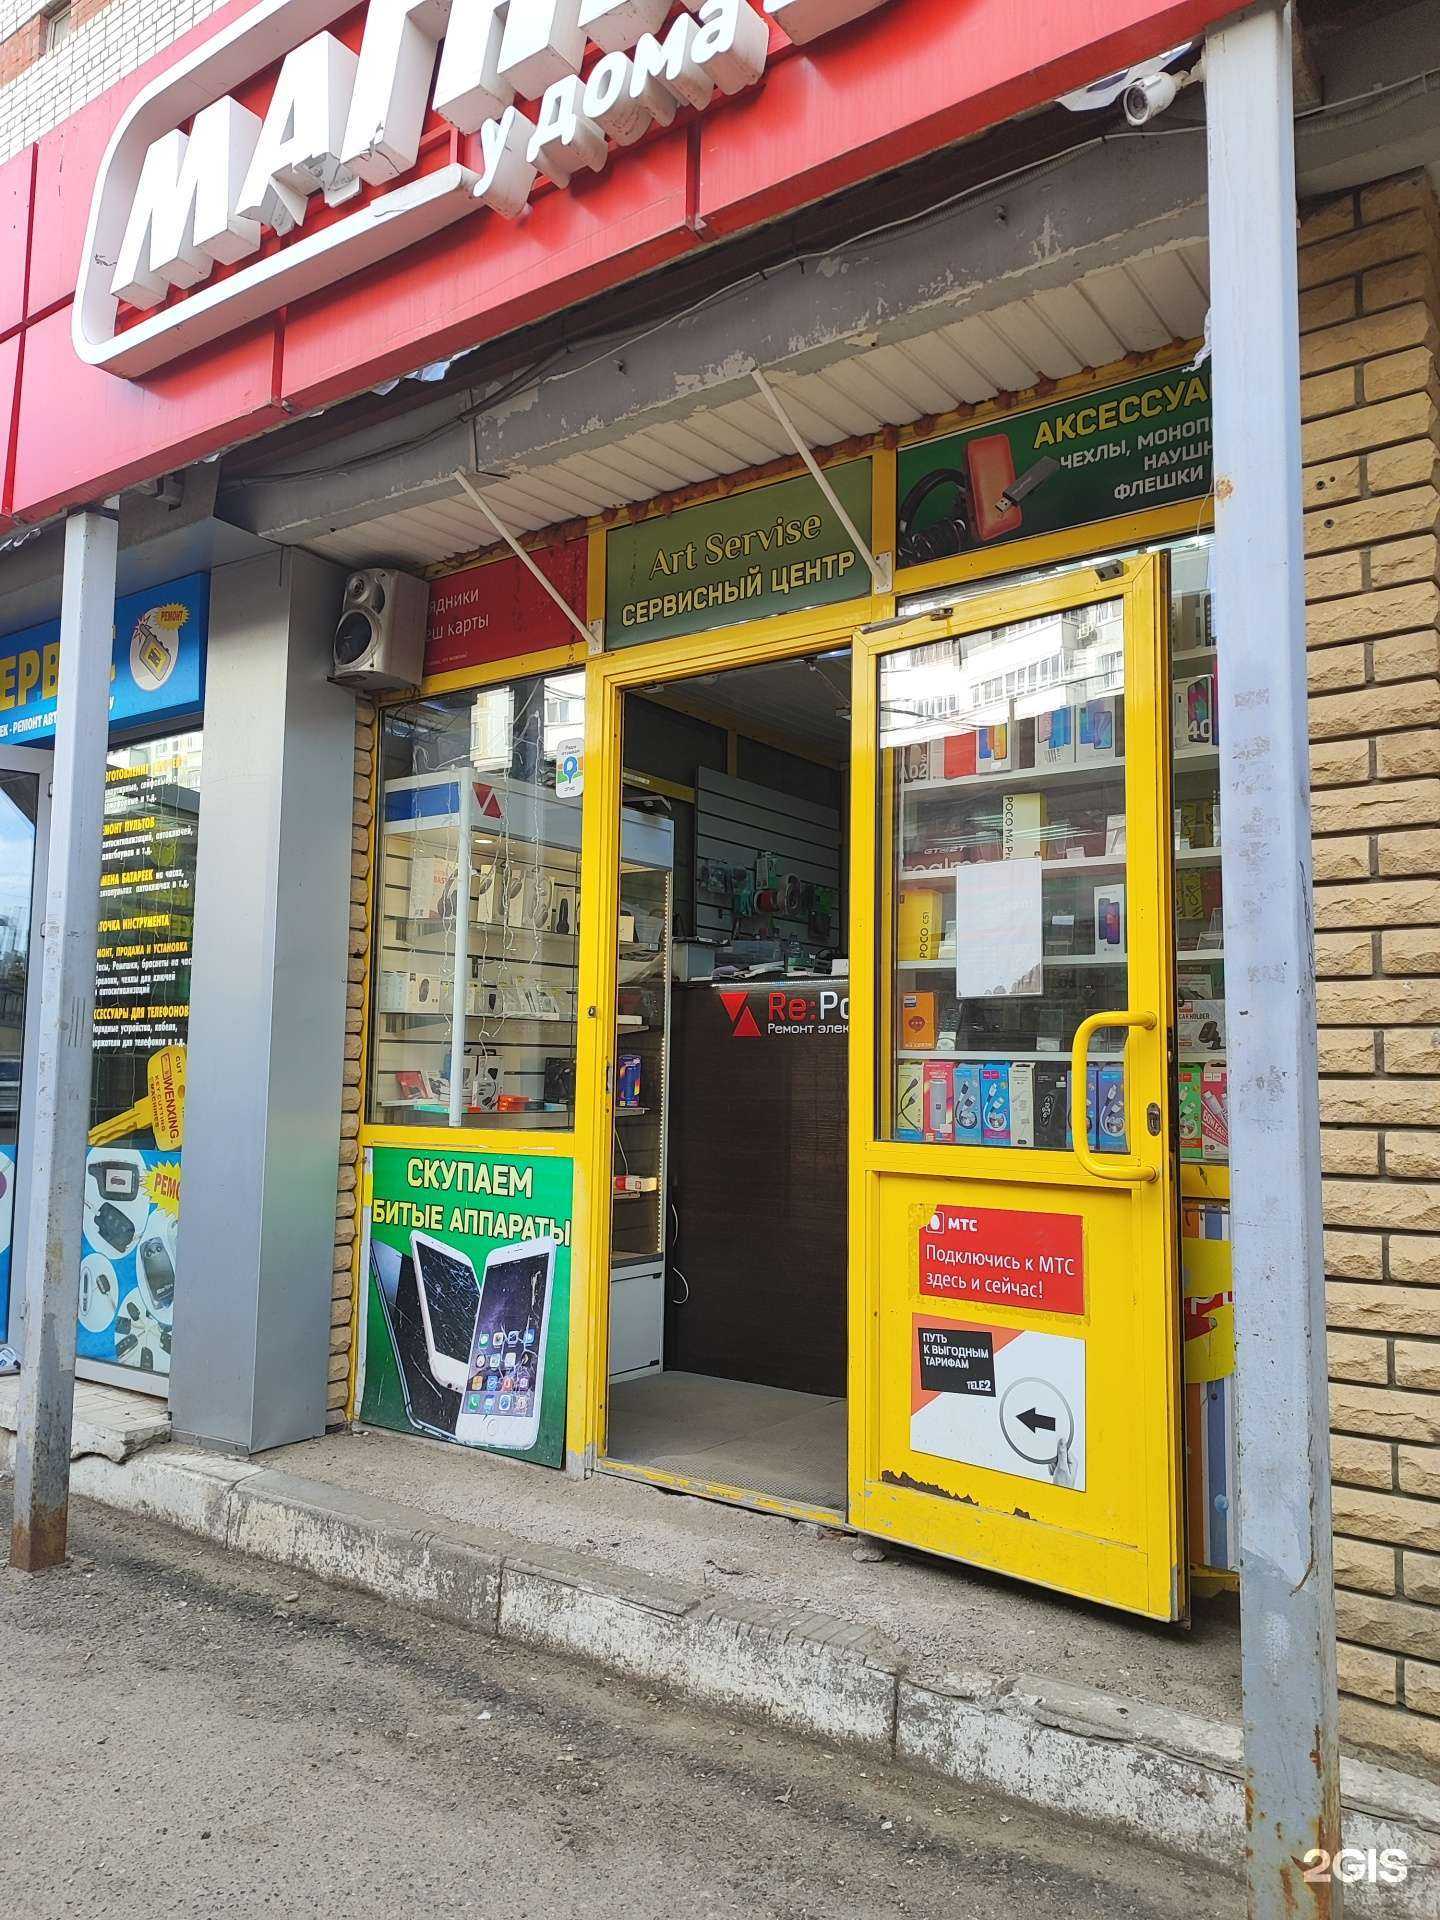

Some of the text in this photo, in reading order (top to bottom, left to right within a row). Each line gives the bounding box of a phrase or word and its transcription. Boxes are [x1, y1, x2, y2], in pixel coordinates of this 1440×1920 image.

[473, 0, 742, 197] у дома
[1060, 417, 1213, 470] ЧЕХЛЫ, МОНОП
[1114, 465, 1203, 500] ФЛЕШКИ
[649, 512, 822, 580] Art Servise
[621, 549, 855, 628] СЕРВИСНЫЙ ЦЕНТР
[448, 614, 489, 637] карты
[13, 715, 42, 733] РЕМОНТ
[1005, 797, 1013, 826] POCO
[125, 816, 155, 832] ПУЛЬТОВ
[122, 869, 154, 883] БАТАРЕЕК
[122, 914, 170, 930] ИНСТРУМЕНТА
[116, 945, 144, 957] ПРОДАЖА
[147, 944, 151, 954] И
[154, 942, 188, 954] УСТАНОВКА
[920, 928, 928, 958] POCO
[131, 1006, 145, 1020] ДЛЯ
[147, 1005, 190, 1018] ТЕЛЕФОНОВ
[768, 1023, 815, 1034] Ремонт
[164, 1076, 179, 1139] WENXING
[407, 1158, 534, 1198] СКУПАЕМ
[372, 1199, 571, 1247] БИТЫЕ АППАРАТЫ
[948, 1217, 978, 1232] МТС
[926, 1244, 1075, 1276] Подключись к МТС
[926, 1272, 1043, 1299] здесь и сейчас!
[923, 1332, 948, 1343] ПУТЬ
[923, 1344, 989, 1359] К ВЫГОДНЫМ
[924, 1356, 969, 1369] ТАРИФАМ
[966, 1379, 992, 1392] TELE2
